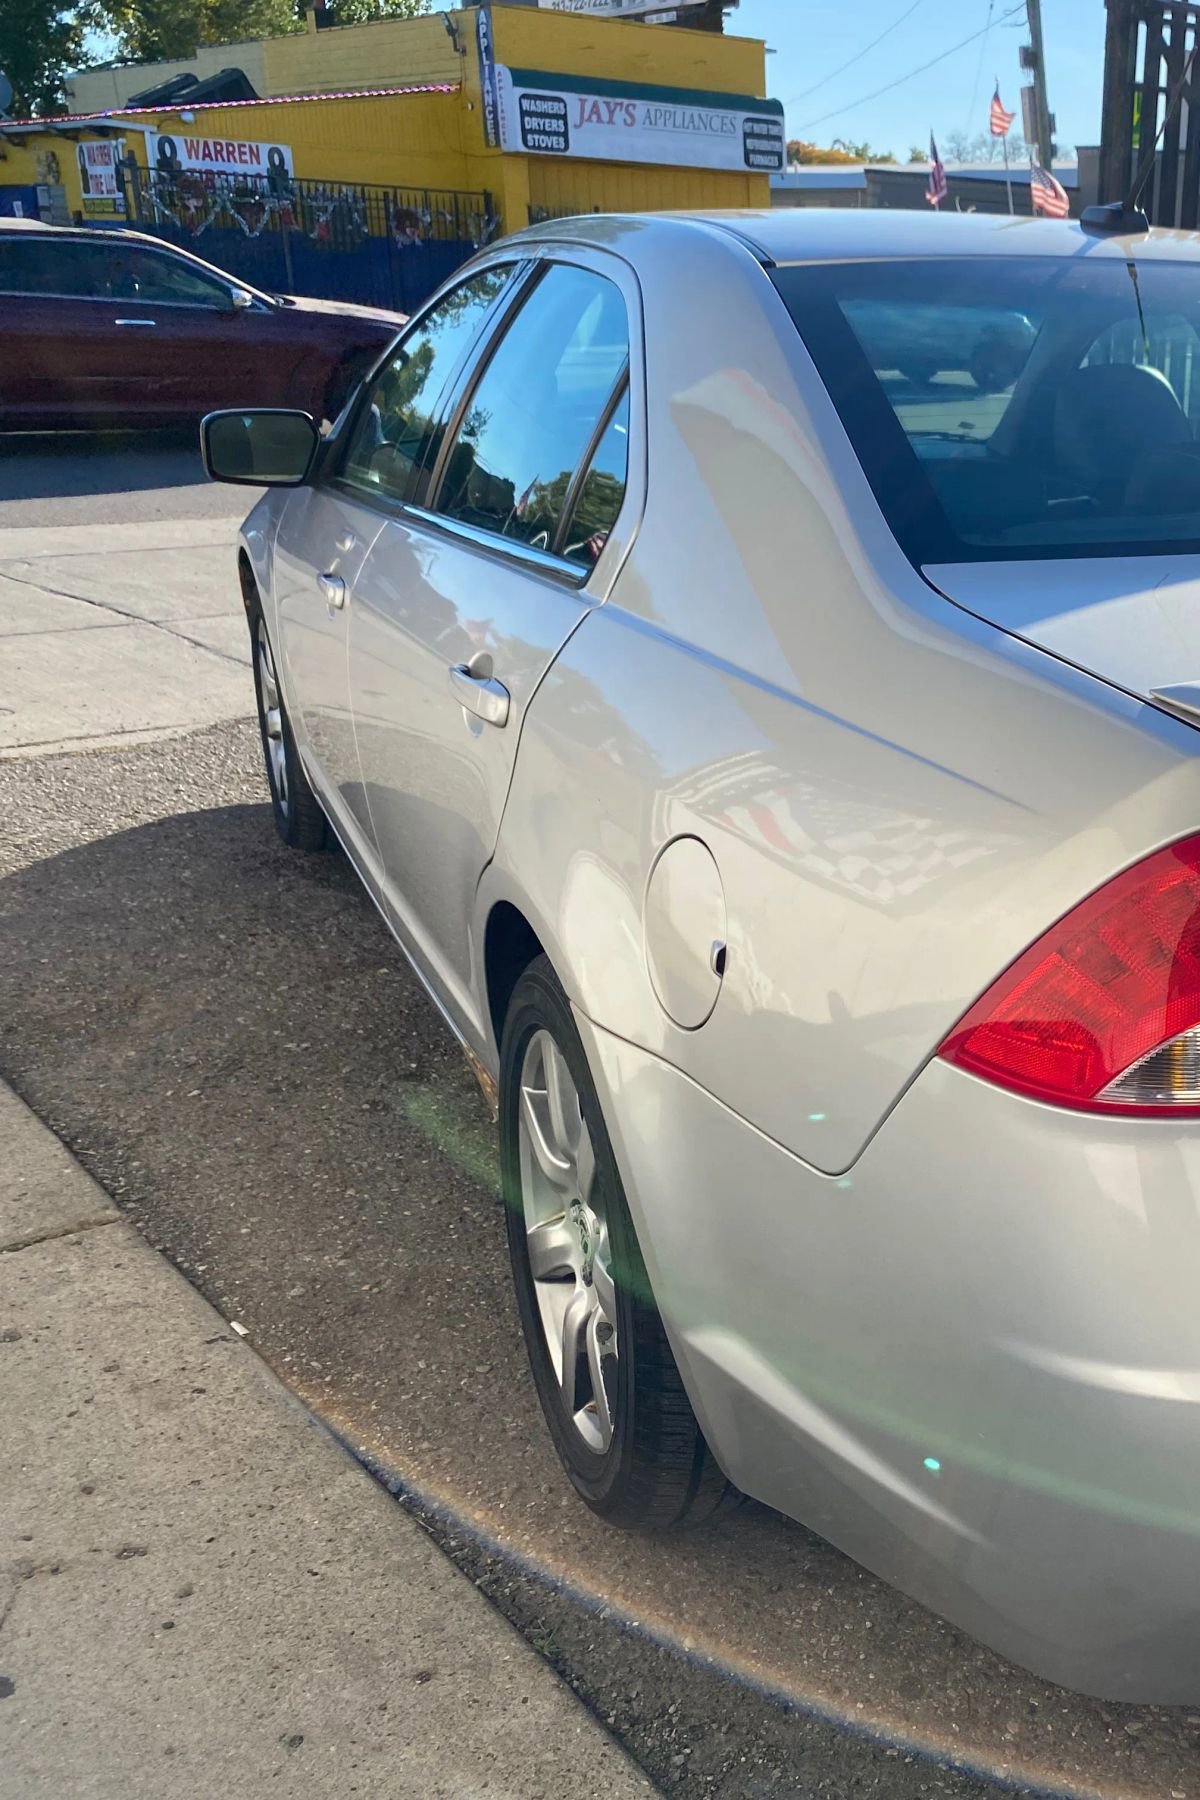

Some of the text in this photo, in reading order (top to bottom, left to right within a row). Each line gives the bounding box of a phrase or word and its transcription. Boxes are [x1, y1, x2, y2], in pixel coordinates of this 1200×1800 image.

[478, 9, 497, 147] APPLIANCES
[521, 98, 566, 115] WASHERS
[574, 97, 737, 135] JAY'S APPLIANCES
[524, 116, 565, 132] DRYERS
[184, 138, 261, 165] WARREN
[527, 134, 565, 150] STOVES
